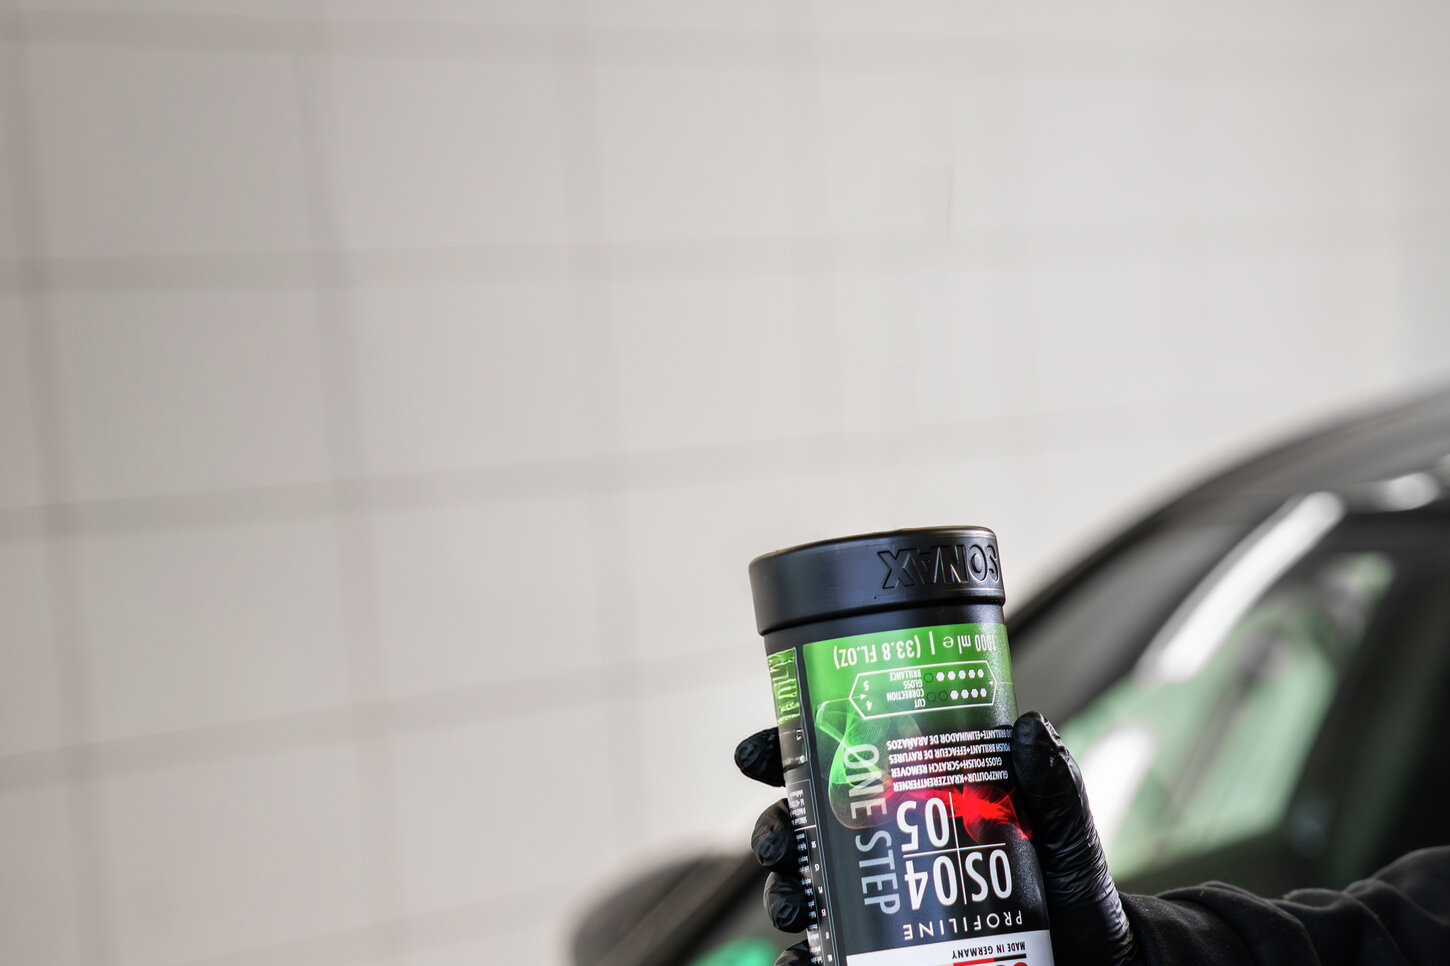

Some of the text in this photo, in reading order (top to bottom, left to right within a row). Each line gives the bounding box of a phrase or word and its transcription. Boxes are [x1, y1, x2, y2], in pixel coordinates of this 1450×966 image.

[877, 543, 999, 590] SONAX
[882, 635, 922, 661] (33.8
[957, 634, 972, 655] ml
[974, 634, 997, 652] 1000
[833, 645, 878, 670] FL.OZ)
[889, 669, 922, 681] BRILLANCE
[863, 680, 870, 691] 5
[903, 679, 923, 690] GLOSS
[886, 688, 925, 702] CORRECTION
[914, 698, 926, 709] CUT
[886, 736, 929, 751] ARAÑAZOS
[930, 735, 940, 743] DE
[888, 750, 923, 765] RAYURES
[924, 749, 934, 759] DE
[985, 757, 1003, 767] GLOSS
[891, 764, 928, 778] REMOVER
[843, 743, 901, 915] ONE STEP
[896, 797, 950, 852] 05
[904, 855, 958, 911] 04
[902, 910, 1023, 941] PROFILINE
[952, 941, 1026, 960] MADE IN GERMANY
